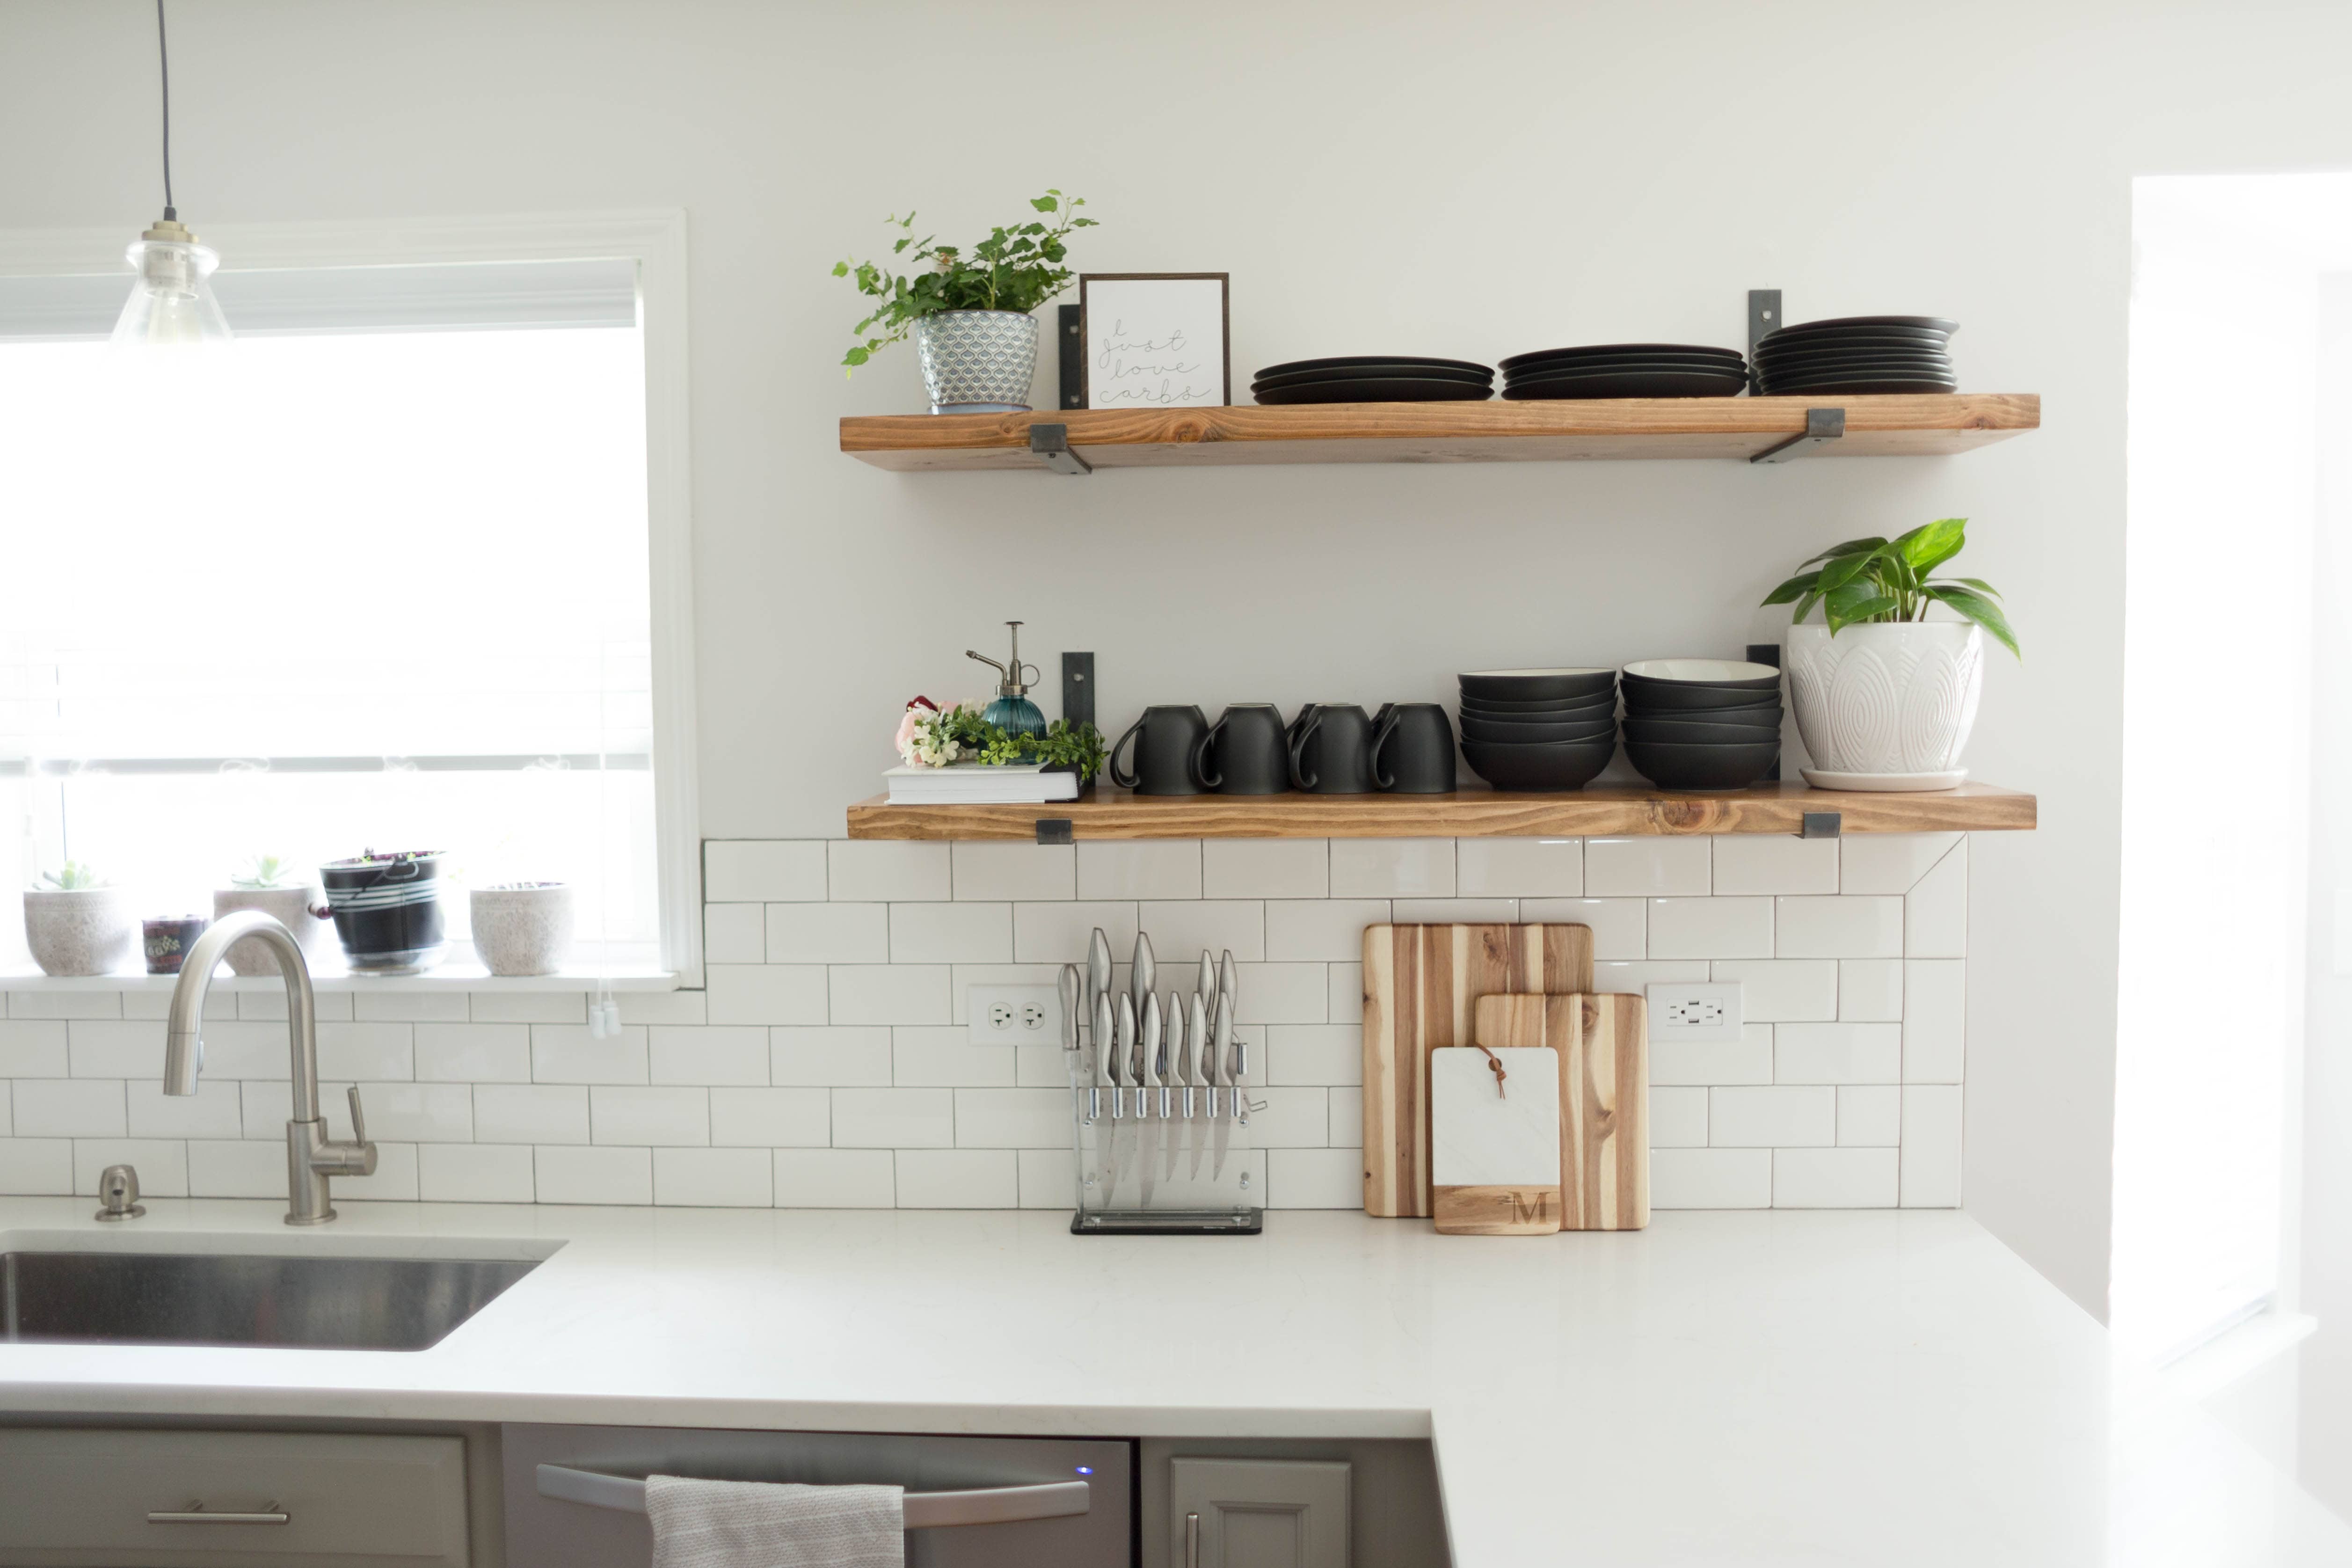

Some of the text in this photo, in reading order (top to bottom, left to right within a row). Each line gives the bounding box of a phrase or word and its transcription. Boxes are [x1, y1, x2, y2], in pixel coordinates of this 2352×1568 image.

[1110, 359, 1201, 380] love
[1100, 379, 1212, 404] carbs
[1508, 1191, 1551, 1225] M
